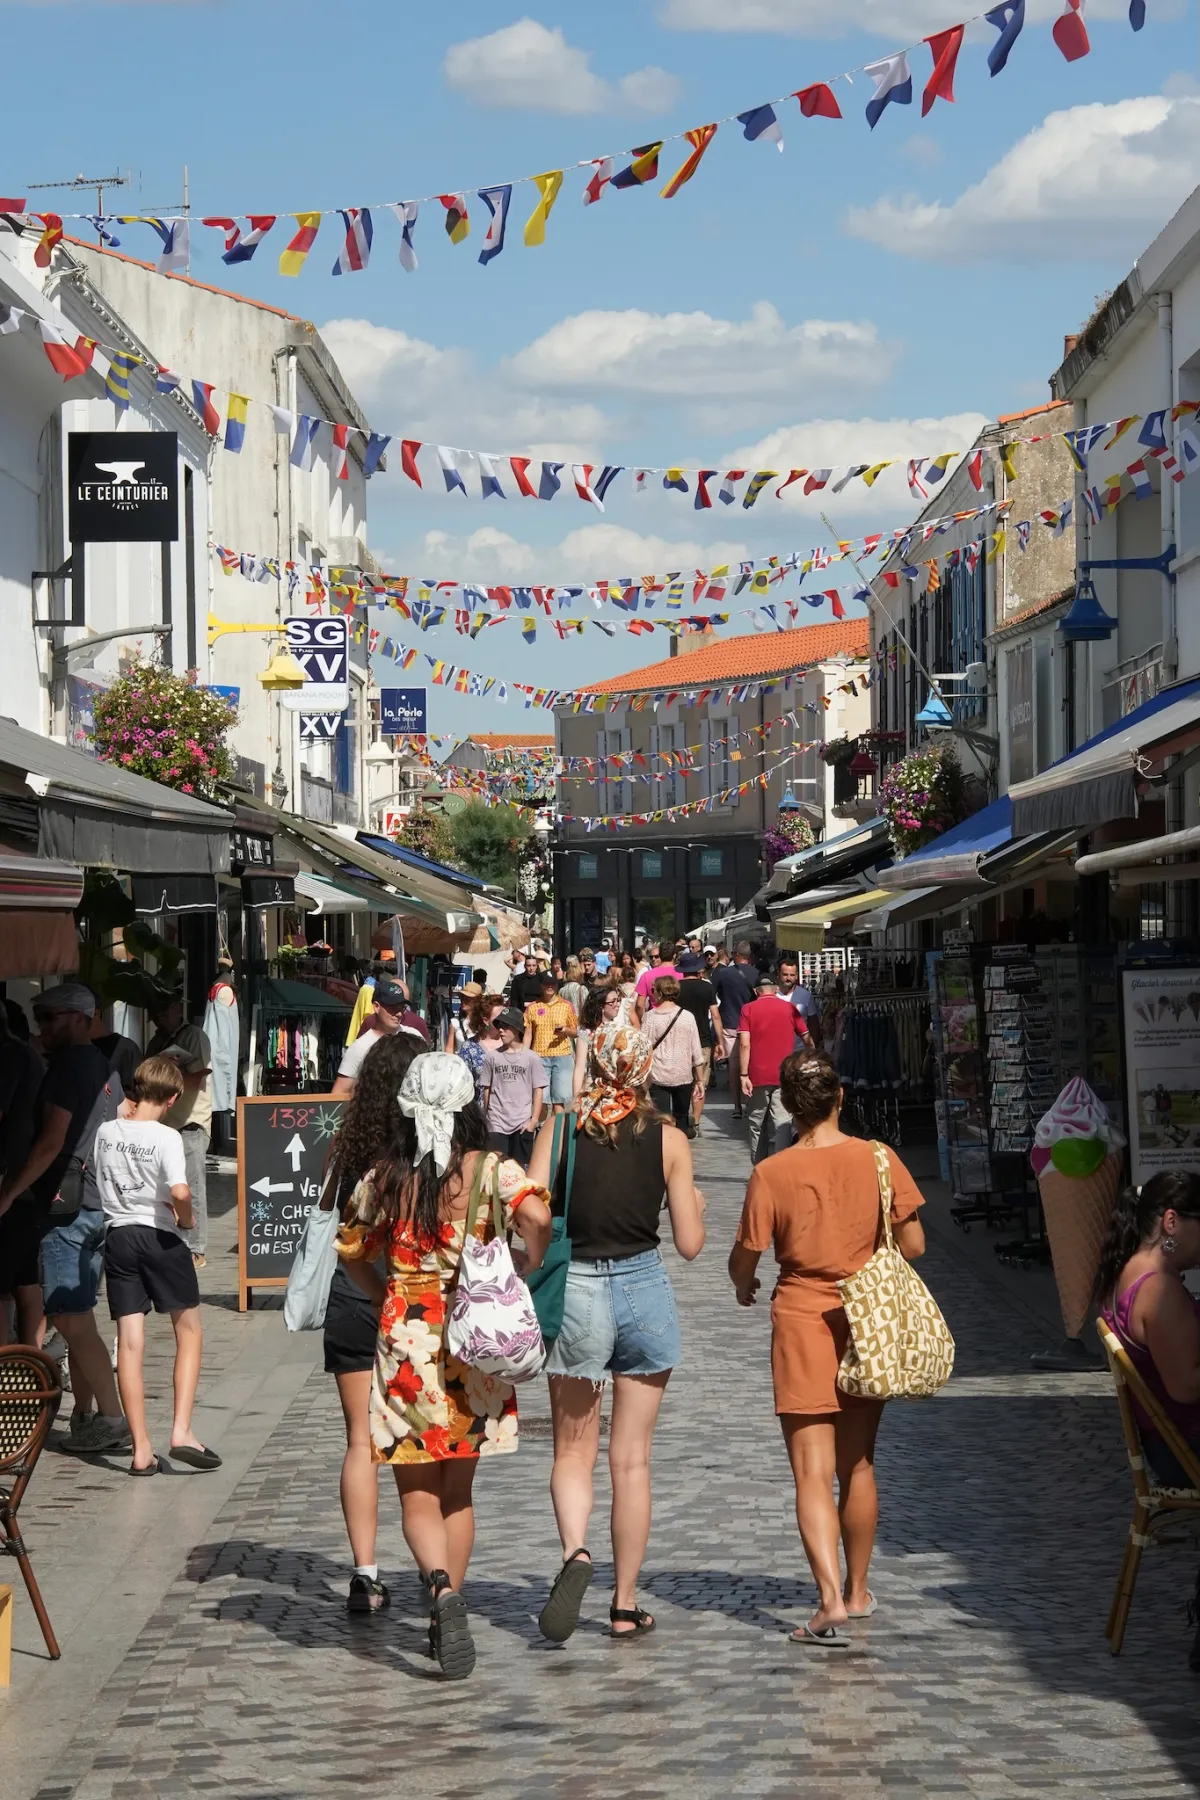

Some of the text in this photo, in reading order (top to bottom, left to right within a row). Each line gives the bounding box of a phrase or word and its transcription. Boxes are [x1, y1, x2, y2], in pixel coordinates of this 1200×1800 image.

[78, 486, 169, 501] LE CEINTURIER
[284, 620, 345, 645] SG
[397, 706, 423, 717] Perle
[300, 716, 342, 736] XV
[494, 1064, 527, 1075] NEW YORK
[502, 1072, 517, 1080] STATE
[98, 1138, 156, 1158] The Original
[281, 1204, 312, 1219] CHE
[249, 1242, 270, 1256] ON
[273, 1240, 293, 1254] EST
